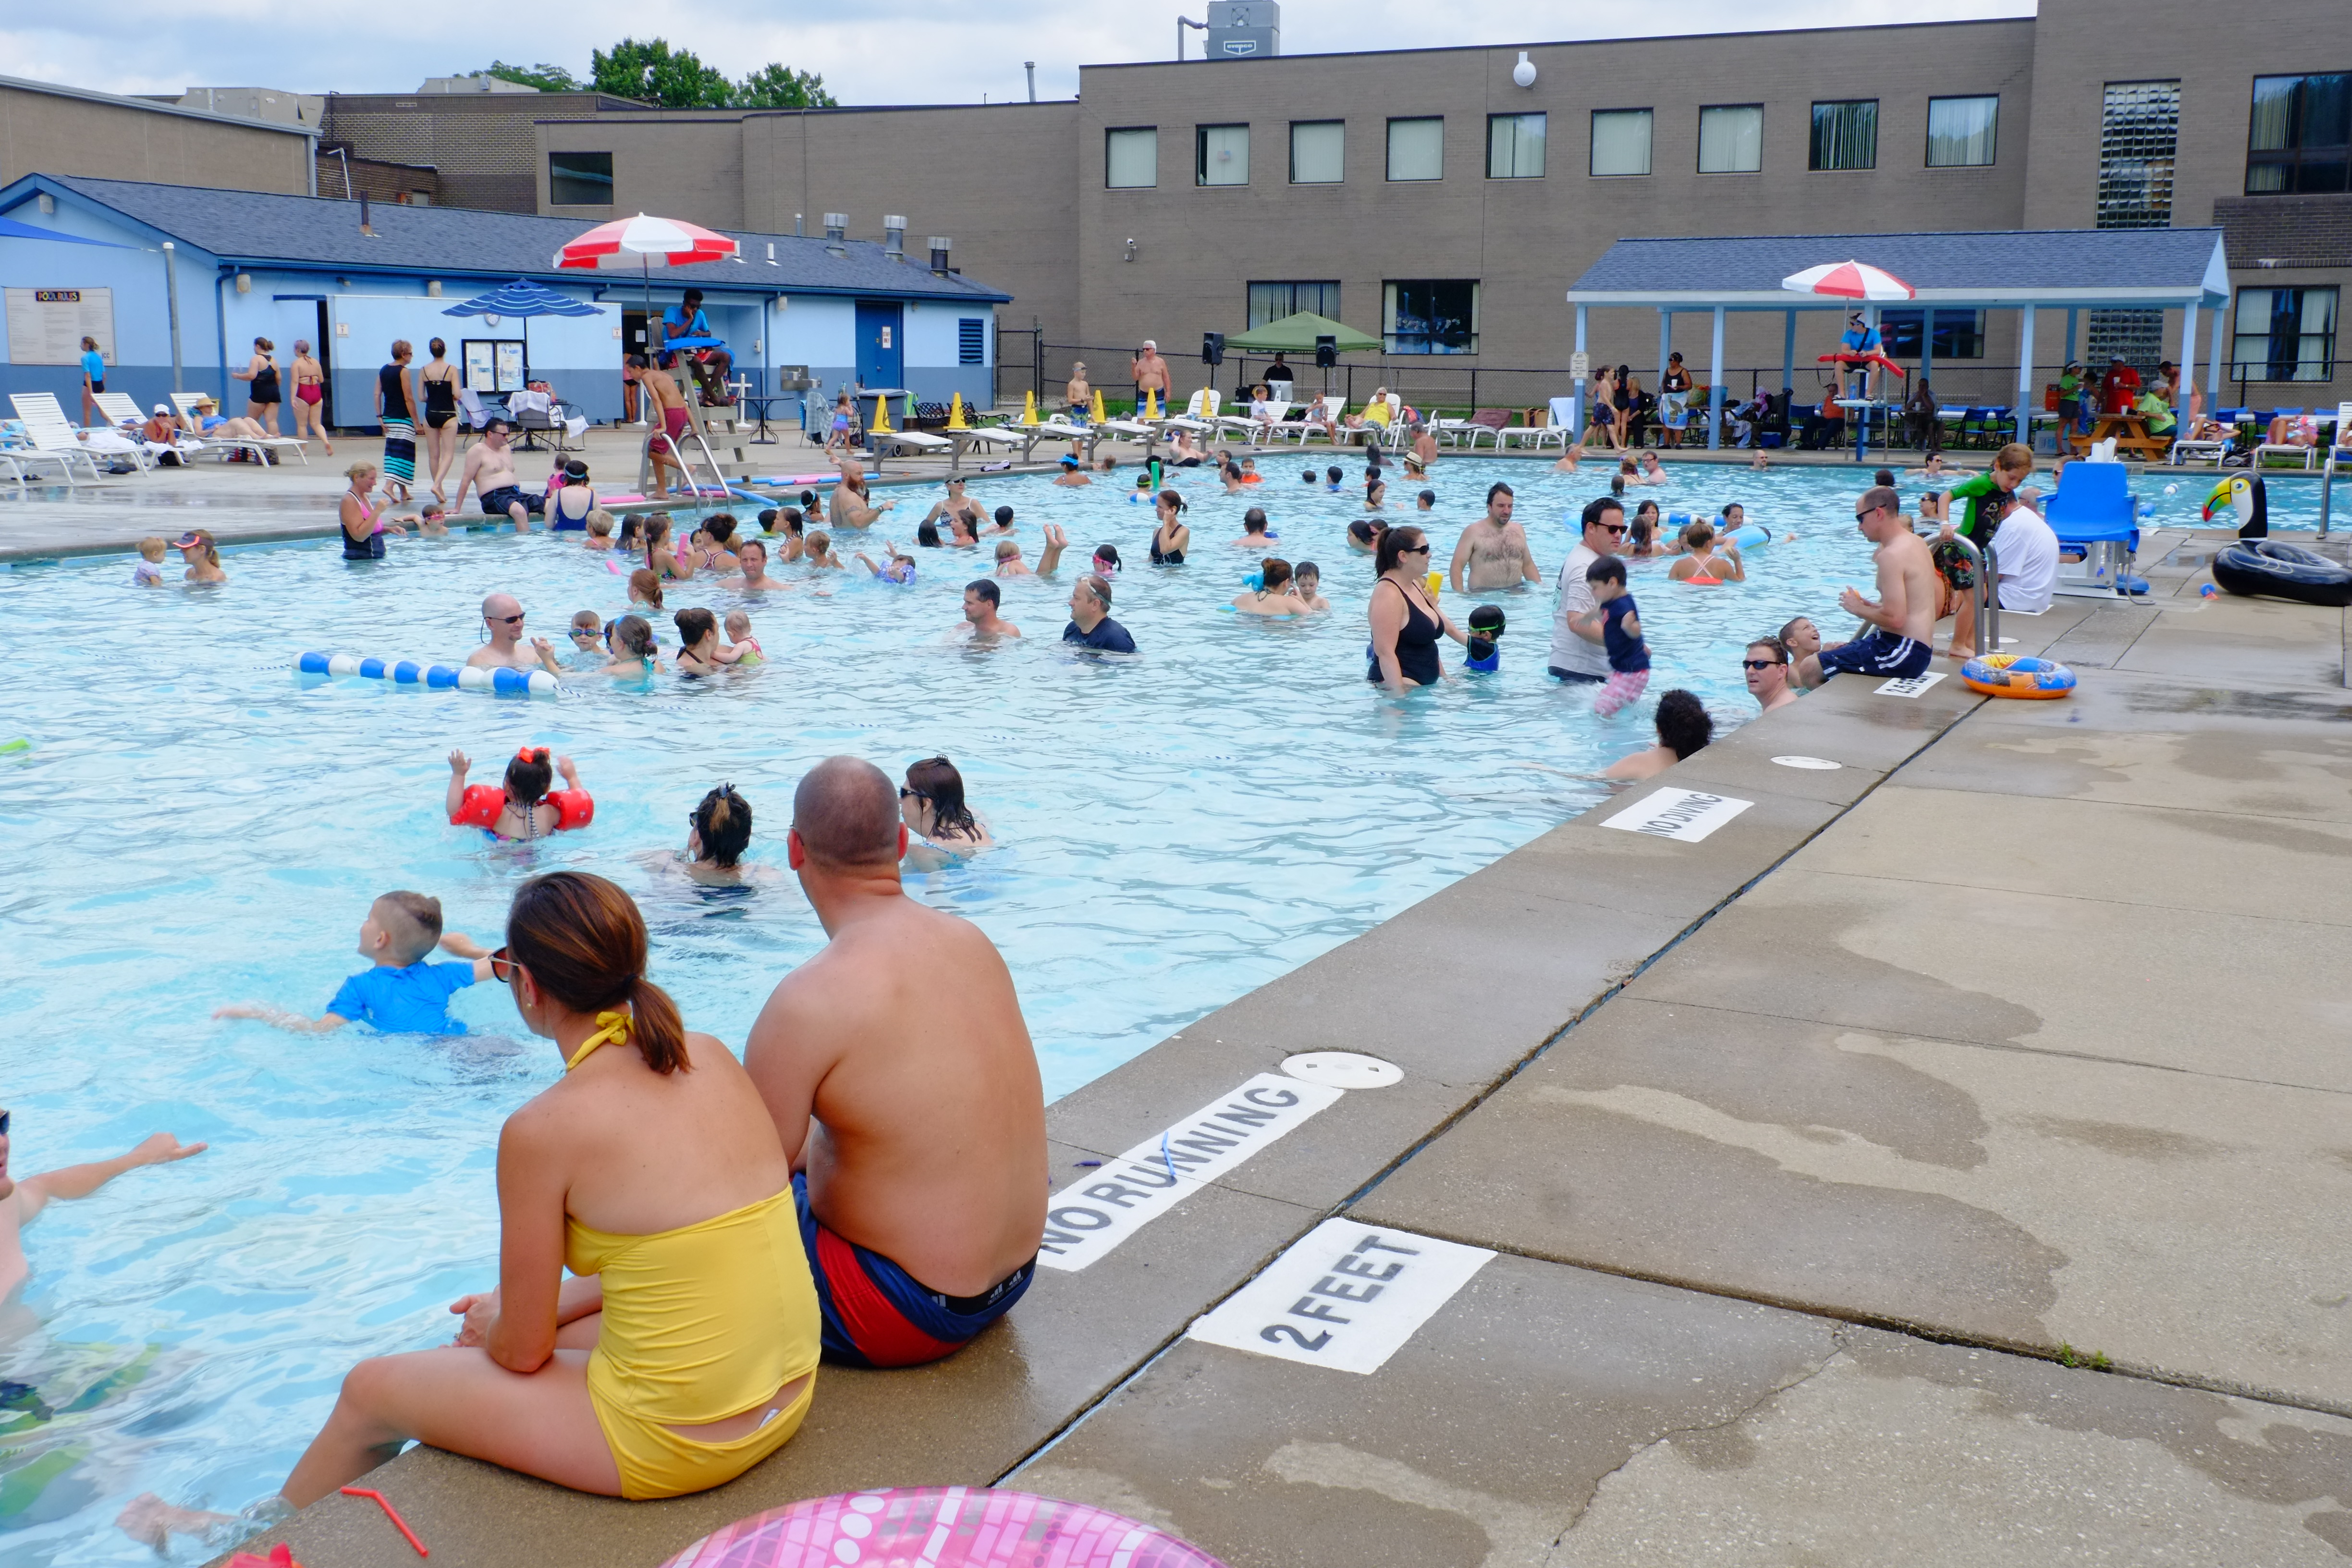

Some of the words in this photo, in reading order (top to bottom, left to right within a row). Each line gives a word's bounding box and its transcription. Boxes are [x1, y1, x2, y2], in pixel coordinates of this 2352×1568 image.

[38, 292, 57, 301] POOL
[58, 292, 77, 302] RULES
[1657, 794, 1722, 822] DIVING
[1637, 821, 1682, 836] NO
[1081, 1088, 1299, 1208] RUNNING
[1287, 1235, 1420, 1324] FEET
[1260, 1324, 1333, 1352] 2
